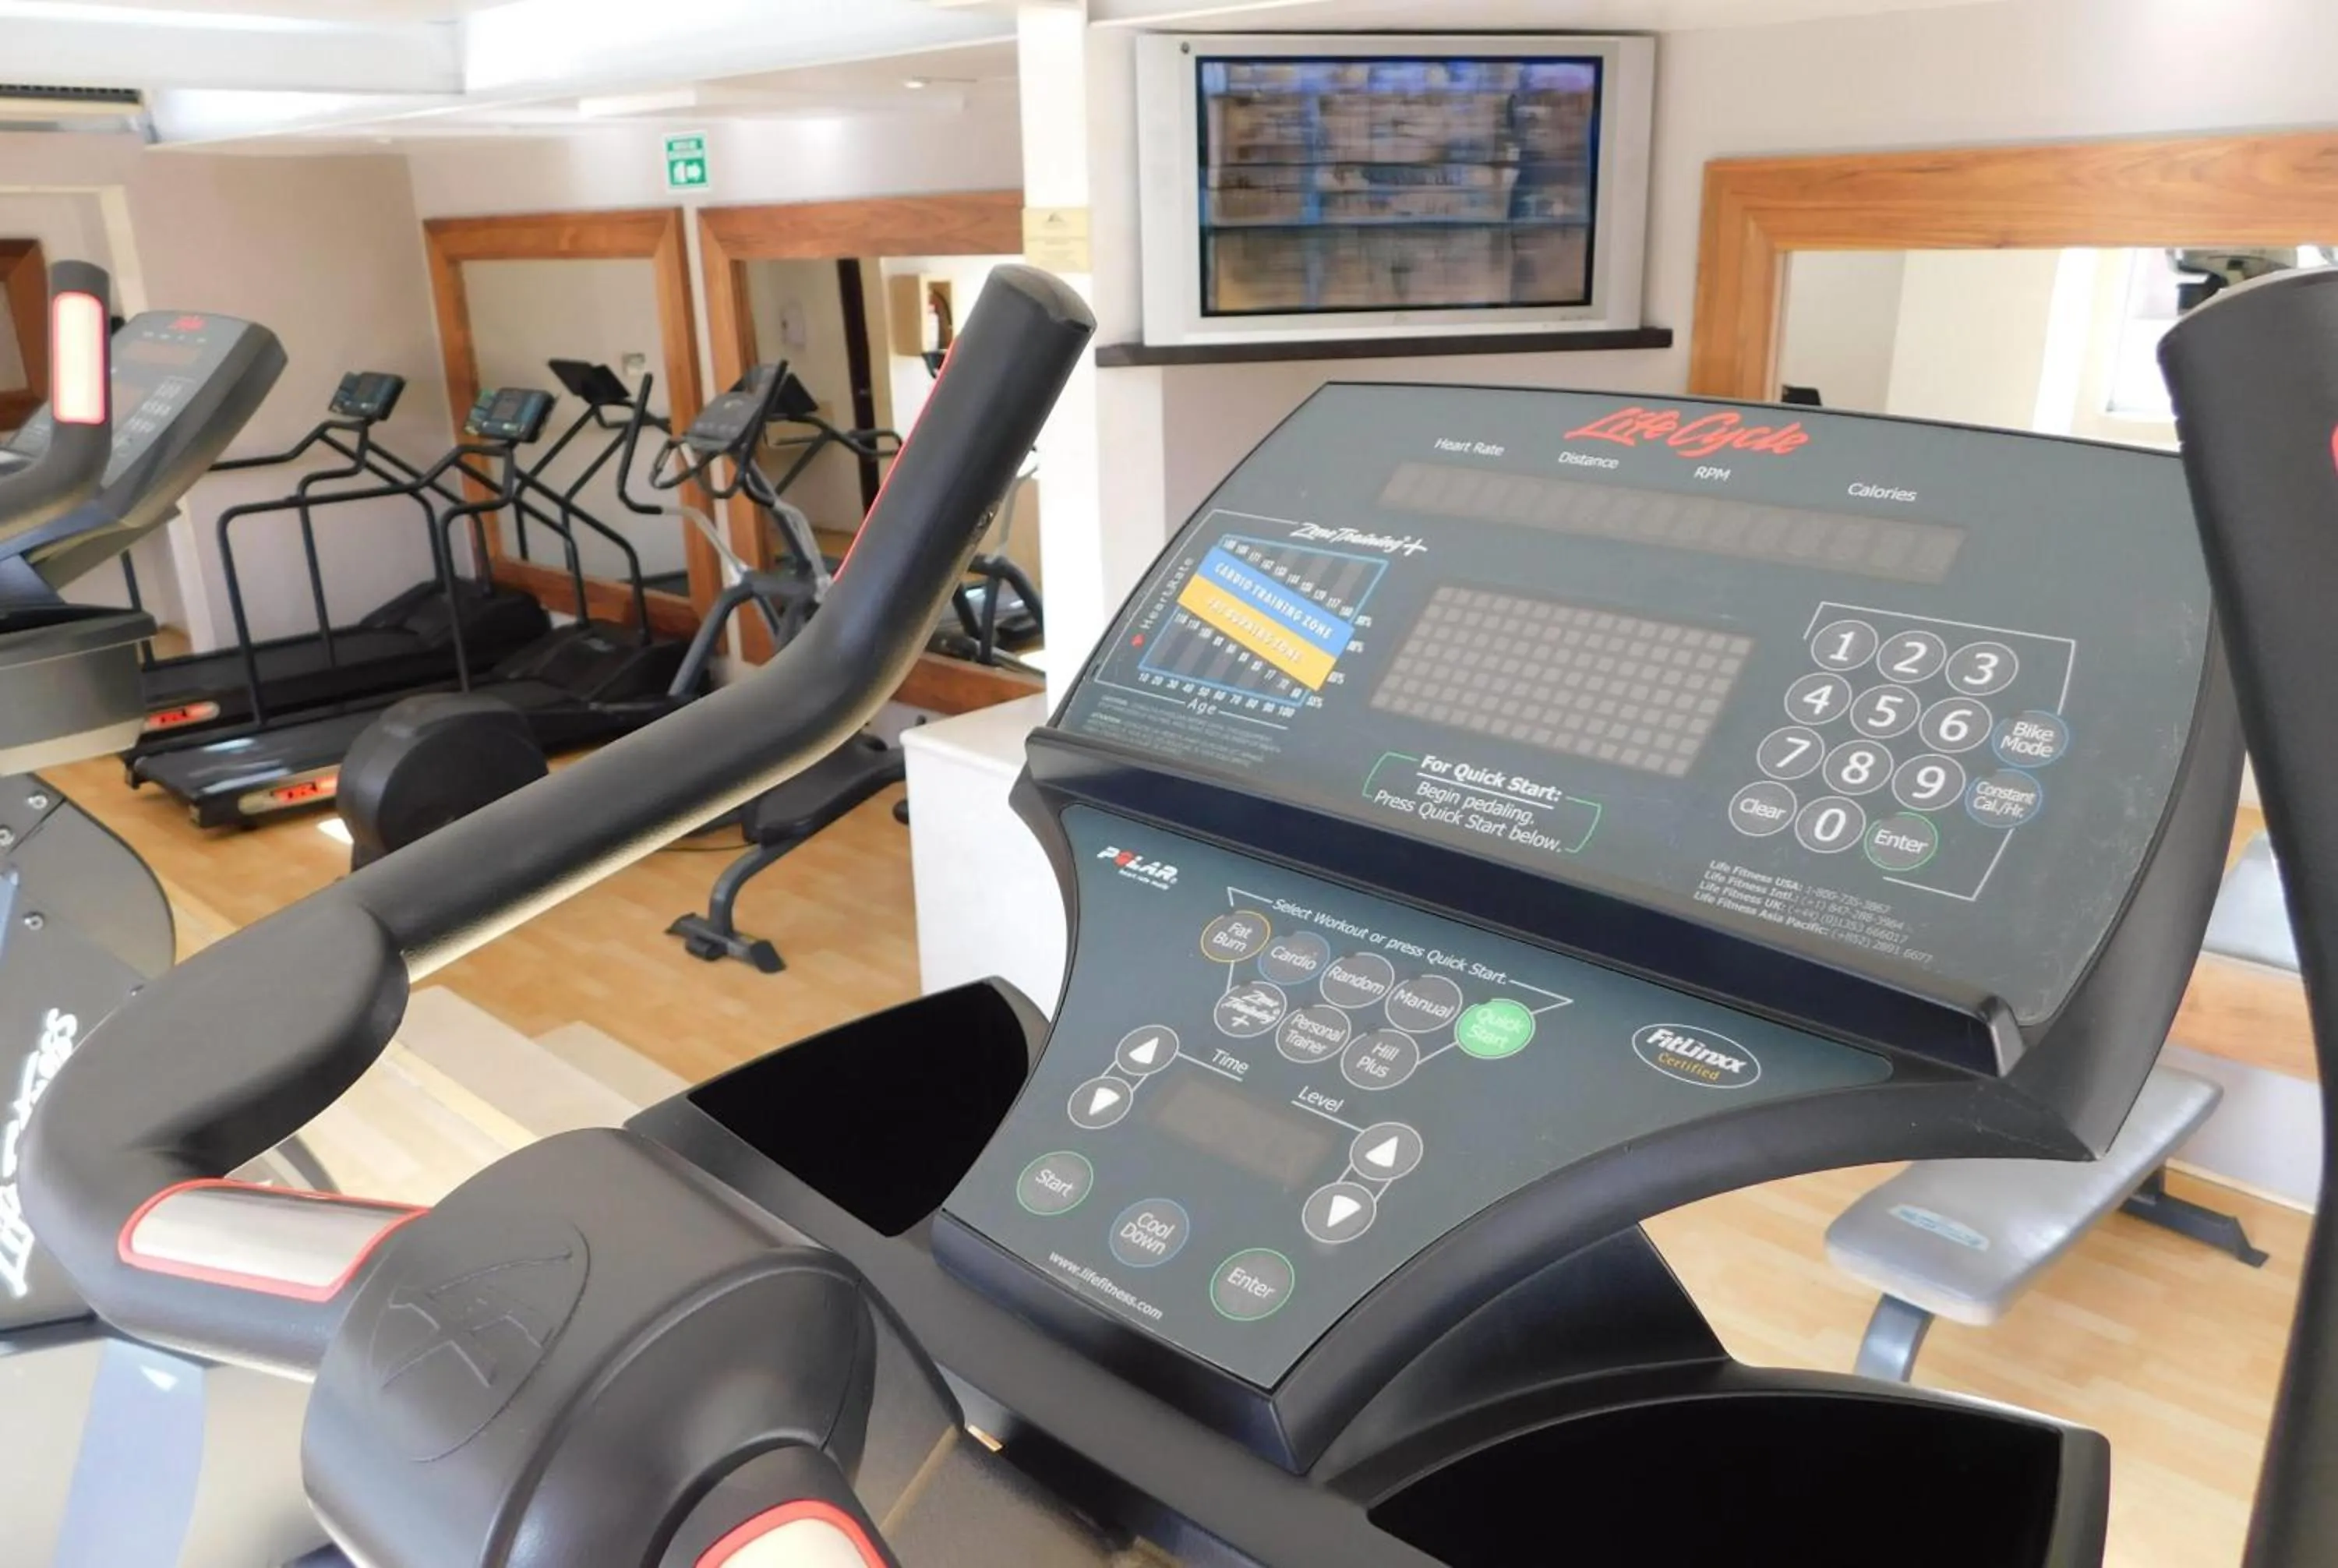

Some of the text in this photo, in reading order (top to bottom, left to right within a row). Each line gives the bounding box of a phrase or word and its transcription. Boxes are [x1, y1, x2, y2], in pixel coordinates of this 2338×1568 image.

[1563, 407, 1809, 457] Life Cycle
[1435, 437, 1504, 456] Heart Rate
[1558, 450, 1619, 469] Distance
[1694, 465, 1730, 482] RPM
[1847, 482, 1916, 503] Calories
[1139, 591, 1173, 630] Heart
[1214, 562, 1252, 591] CARDIO
[1252, 584, 1303, 621] TRAINING
[1301, 614, 1333, 640] ZONE
[1828, 630, 1999, 685] 1 2 3
[1187, 698, 1217, 715] Age
[1802, 683, 1972, 741] 4 5 6
[2012, 720, 2054, 742] Bike
[2000, 734, 2054, 758] Mode
[1421, 754, 1562, 802] For Quick Start:
[1776, 737, 1946, 799] 7 8 9
[1416, 782, 1535, 825] Begin pedaling.
[1976, 781, 2036, 806] Constant
[1373, 789, 1562, 853] Press Quick Start below.
[1739, 796, 1786, 820] Clear
[1814, 808, 1846, 842] 0
[1874, 828, 1928, 854] Enter
[1097, 846, 1178, 881] POLAR
[1710, 860, 1731, 873] Life
[1732, 866, 1773, 884] Fitness
[1699, 880, 1720, 893] Life
[1722, 887, 1762, 905] Fitness
[1704, 871, 1725, 882] Life
[1728, 876, 1768, 894] Fitness
[1693, 891, 1716, 904] Life
[1717, 897, 1757, 915] Fitness
[1758, 909, 1784, 923] Asia
[1212, 931, 1247, 952] Burn
[1228, 922, 1252, 939] Fat
[1272, 899, 1312, 921] Select
[1314, 910, 1369, 938] Workout
[1369, 932, 1386, 945] or
[1385, 936, 1425, 959] press
[1427, 949, 1467, 973] Quick
[1270, 946, 1317, 971] Cardio
[1328, 966, 1385, 996] Random
[1393, 989, 1454, 1019] Manual
[1291, 1013, 1347, 1044] Personal
[1476, 1008, 1522, 1033] Quick
[1286, 1029, 1326, 1054] Trainer
[1372, 1042, 1399, 1061] Hill
[1466, 1026, 1510, 1049] Start
[1211, 1048, 1248, 1074] Time
[1356, 1056, 1390, 1078] Plus
[1658, 1052, 1721, 1081] Certified
[1298, 1085, 1344, 1113] Level
[1036, 1167, 1074, 1197] Start
[1137, 1211, 1175, 1239] Cool
[1120, 1224, 1167, 1255] Down
[1048, 1251, 1164, 1320] www.lifefitness.com
[1227, 1266, 1277, 1298] Enter
